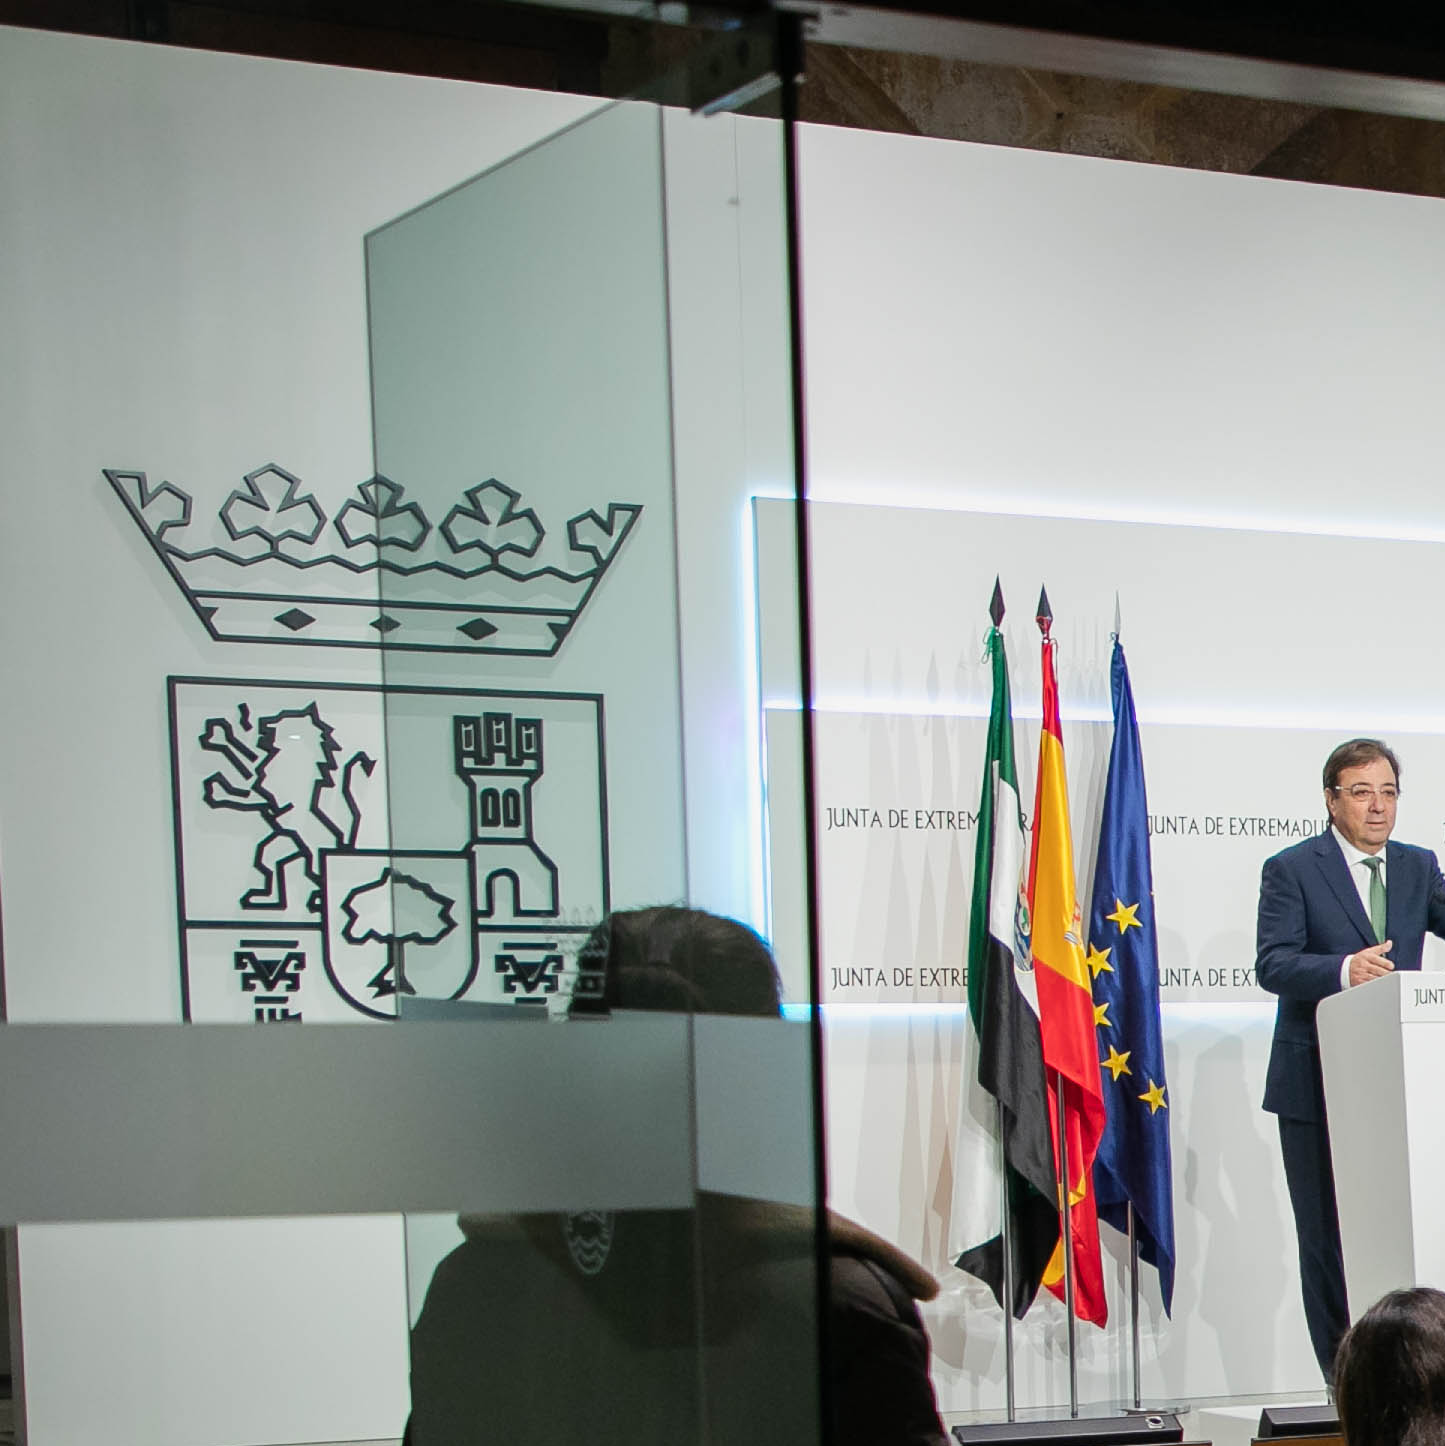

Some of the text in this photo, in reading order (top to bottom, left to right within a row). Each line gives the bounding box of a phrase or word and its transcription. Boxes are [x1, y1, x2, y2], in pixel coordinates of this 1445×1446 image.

[827, 807, 1034, 831] JUNTA DE EXTREMR
[1147, 815, 1330, 837] JUNTA DE EXTREMADU
[832, 967, 887, 990] JUNTA
[893, 968, 913, 987] DE
[1159, 968, 1203, 987] UNTA
[1208, 968, 1227, 987] DE
